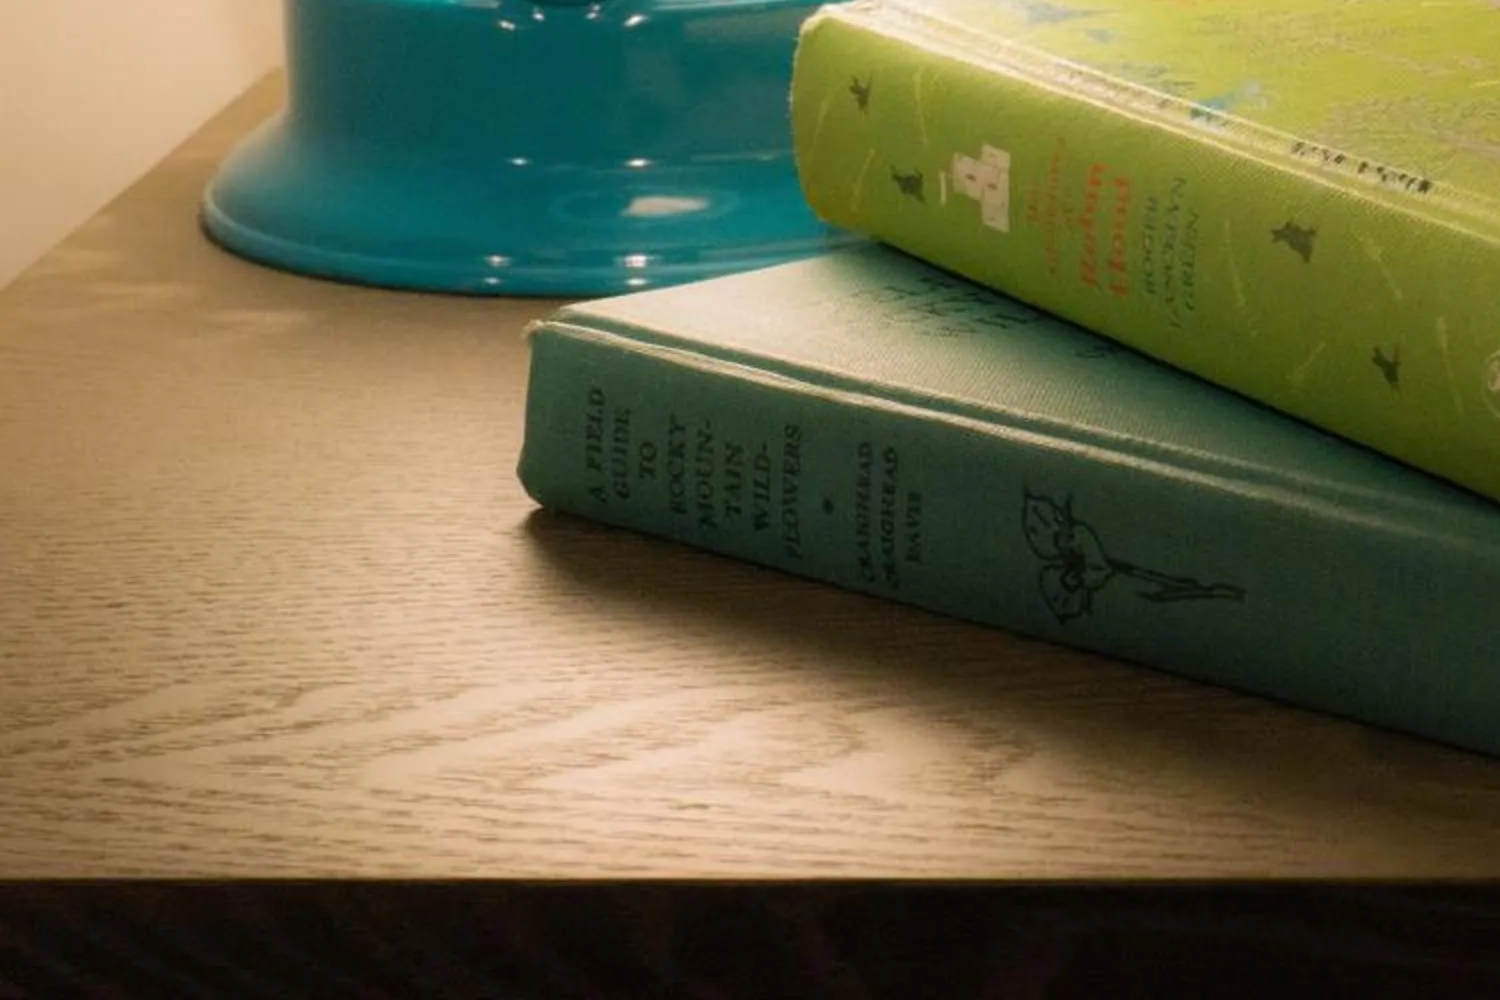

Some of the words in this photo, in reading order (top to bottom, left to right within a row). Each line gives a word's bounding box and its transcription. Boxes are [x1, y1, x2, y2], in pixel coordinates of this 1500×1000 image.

[585, 387, 606, 472] FIELD
[611, 407, 632, 500] GUIDE
[638, 441, 657, 480] TO
[667, 413, 688, 515] ROCKY
[695, 418, 717, 529] MOUN-
[723, 441, 744, 520] TAIN
[752, 441, 771, 532] WILD-
[781, 424, 804, 560] FLOWERS
